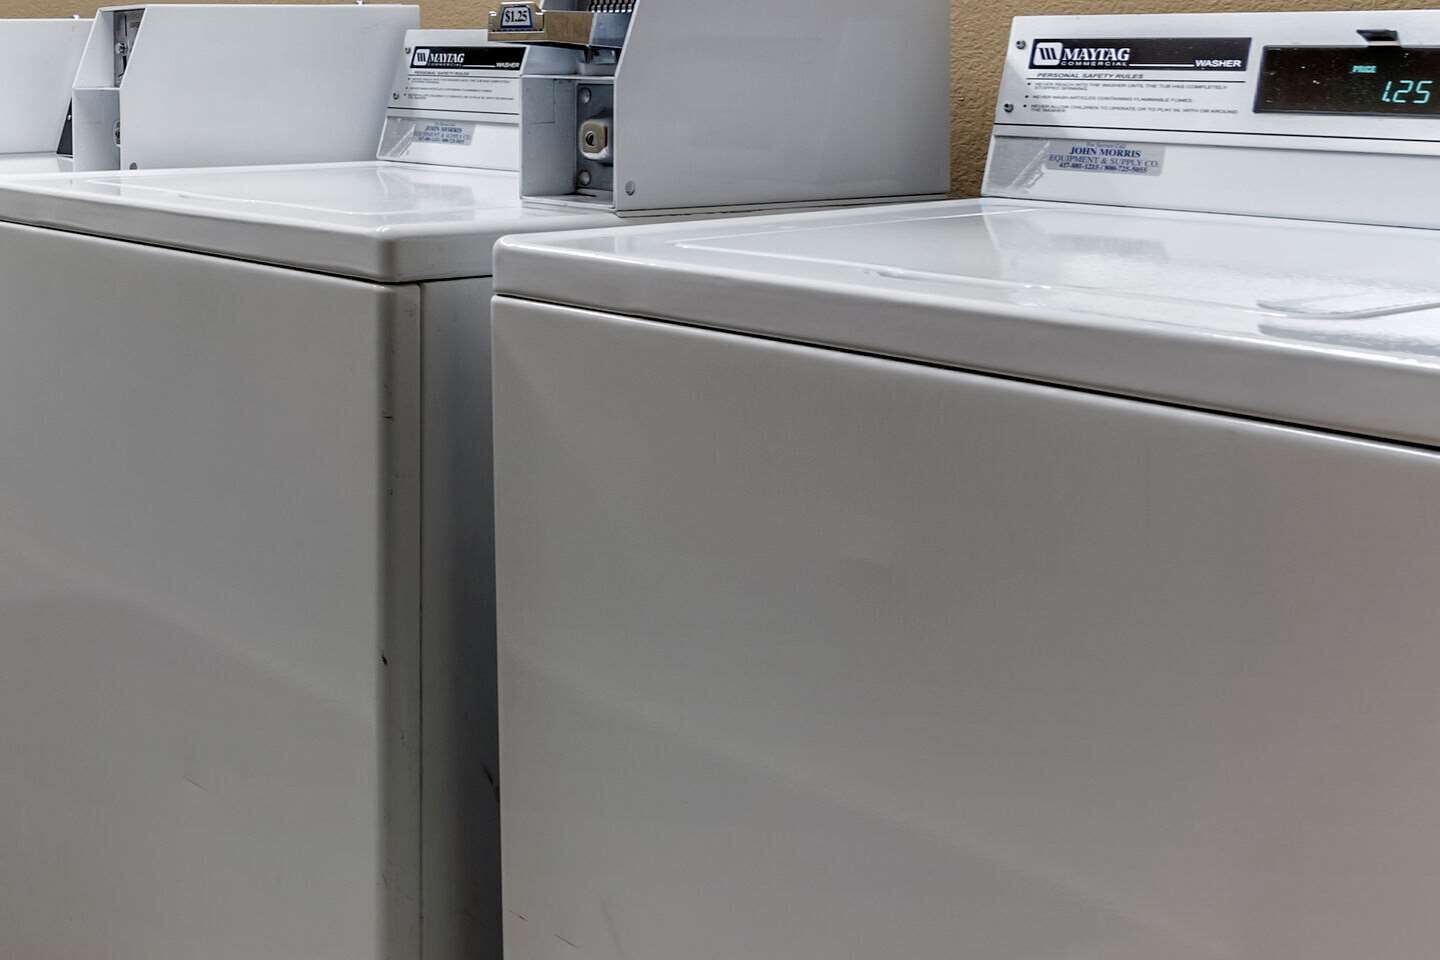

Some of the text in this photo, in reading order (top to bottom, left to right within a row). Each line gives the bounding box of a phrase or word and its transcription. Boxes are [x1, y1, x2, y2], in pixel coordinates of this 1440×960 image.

[504, 9, 528, 23] $1.25
[428, 53, 465, 63] MAYTAG
[1063, 47, 1131, 61] MAYTAG
[1194, 59, 1242, 68] WASHER
[1352, 65, 1377, 73] PRICE
[1382, 80, 1433, 104] 1.25
[1070, 146, 1141, 158] JOHN MORRIS
[1048, 154, 1100, 164] EQUIPMENT
[1110, 157, 1142, 166] SUPPLY
